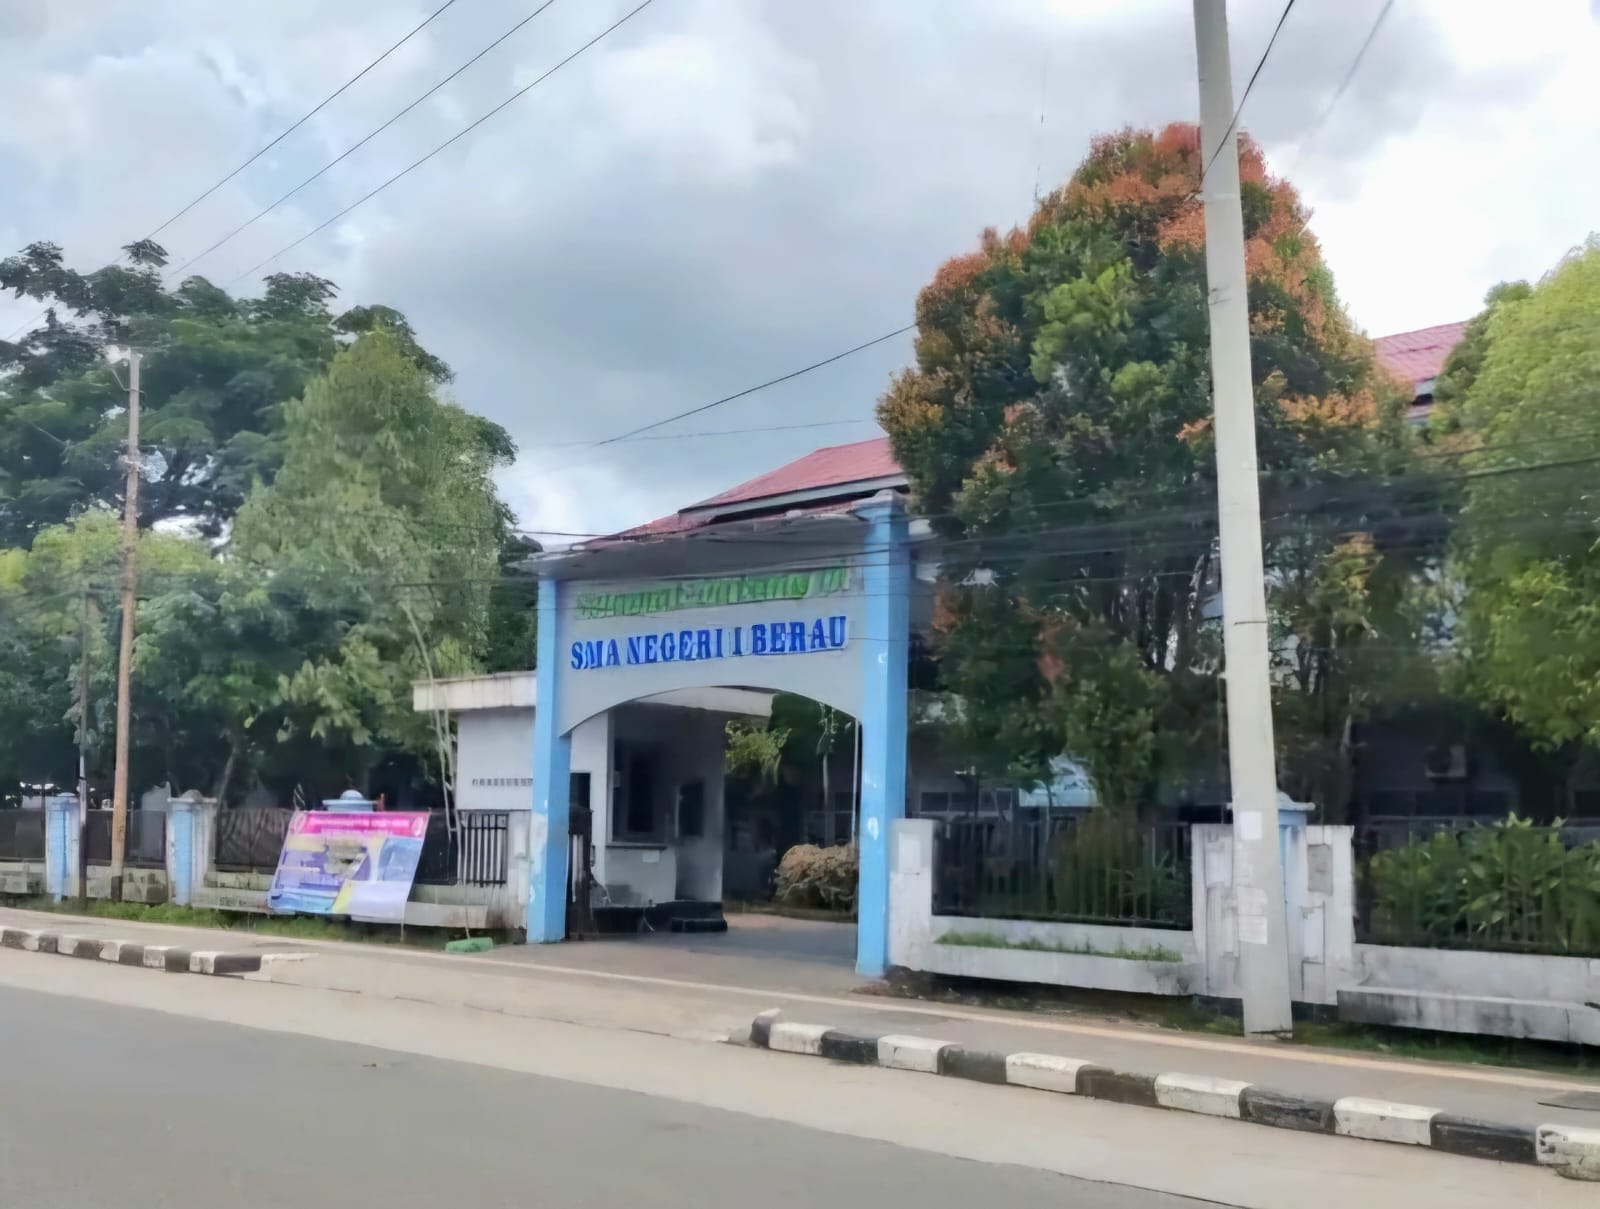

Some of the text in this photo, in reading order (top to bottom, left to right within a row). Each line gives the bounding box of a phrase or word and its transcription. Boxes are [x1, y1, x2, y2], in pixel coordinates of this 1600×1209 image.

[571, 638, 620, 670] SMA
[626, 628, 723, 664] NEGERI
[752, 616, 847, 655] BERAU
